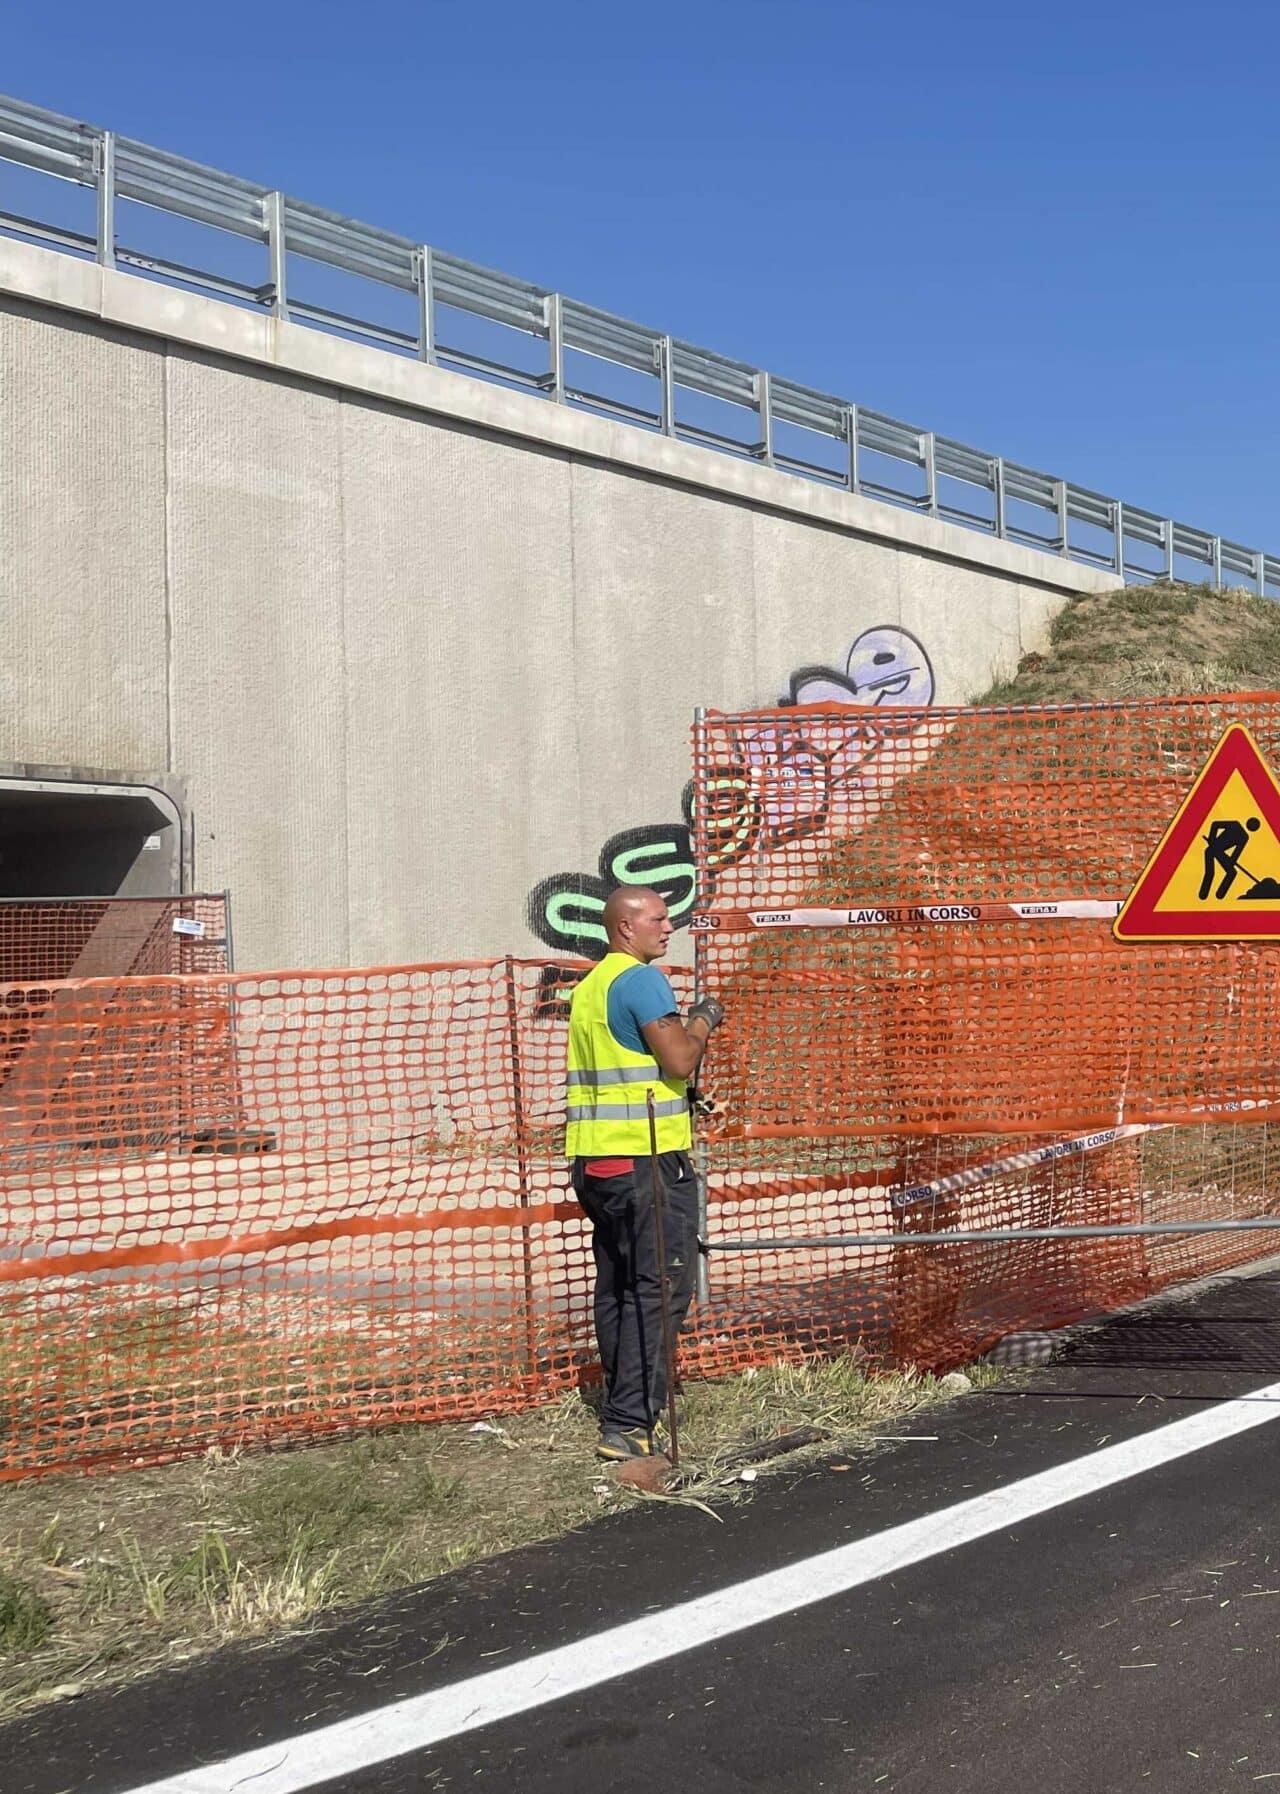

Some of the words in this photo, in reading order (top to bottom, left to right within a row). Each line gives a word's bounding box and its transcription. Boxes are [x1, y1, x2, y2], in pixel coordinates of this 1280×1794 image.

[756, 914, 791, 923] TENAX
[848, 909, 903, 923] LAVORI
[907, 908, 926, 921] IN
[929, 906, 981, 920] CORSO
[1021, 906, 1057, 914] TENAX
[1087, 1130, 1116, 1147] CORSO
